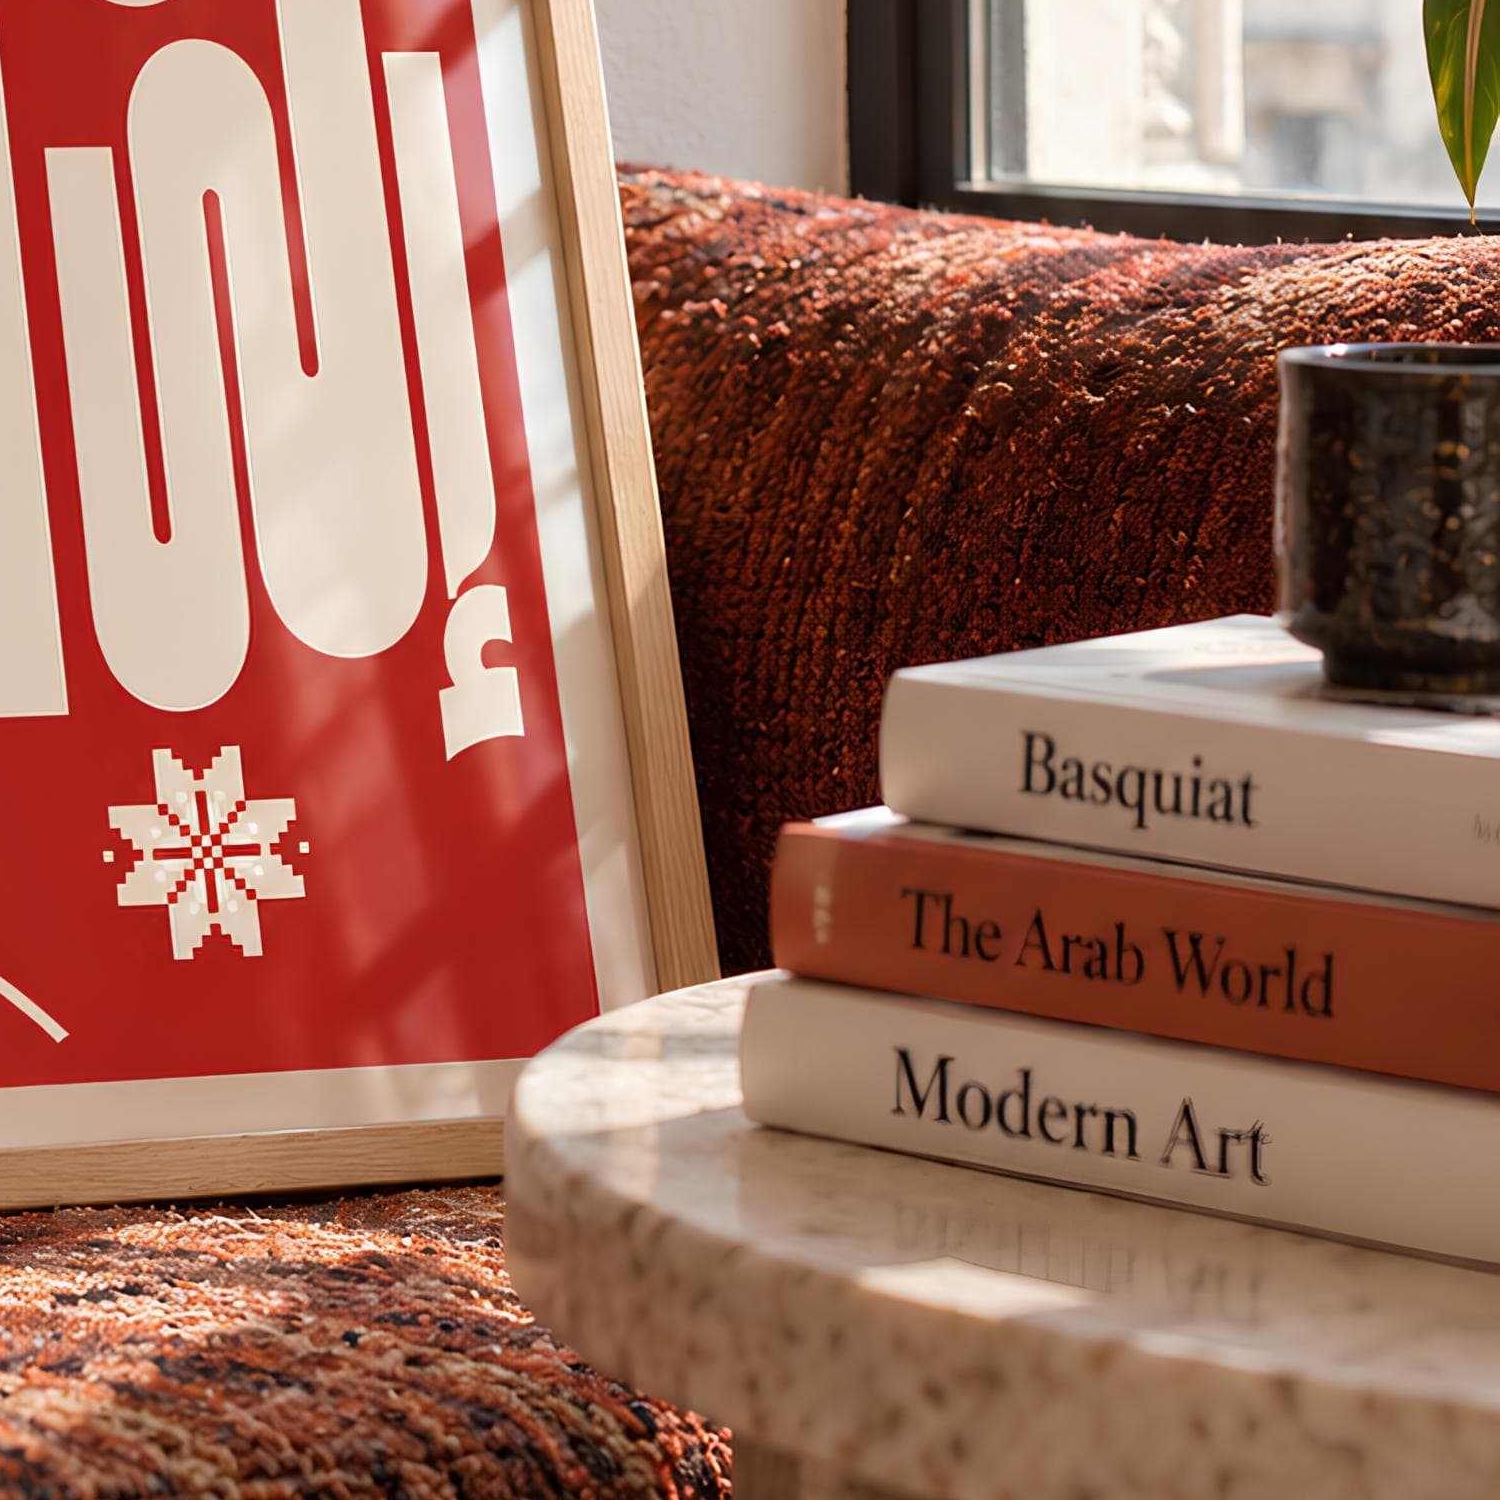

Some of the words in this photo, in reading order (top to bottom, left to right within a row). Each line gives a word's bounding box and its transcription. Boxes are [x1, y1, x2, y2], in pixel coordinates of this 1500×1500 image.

[1020, 731, 1259, 830] Basquiat
[902, 889, 1003, 963] The
[1020, 908, 1146, 984] Arab
[1162, 928, 1336, 1018] World
[891, 1047, 1141, 1160] Modern
[1161, 1097, 1272, 1186] Art
